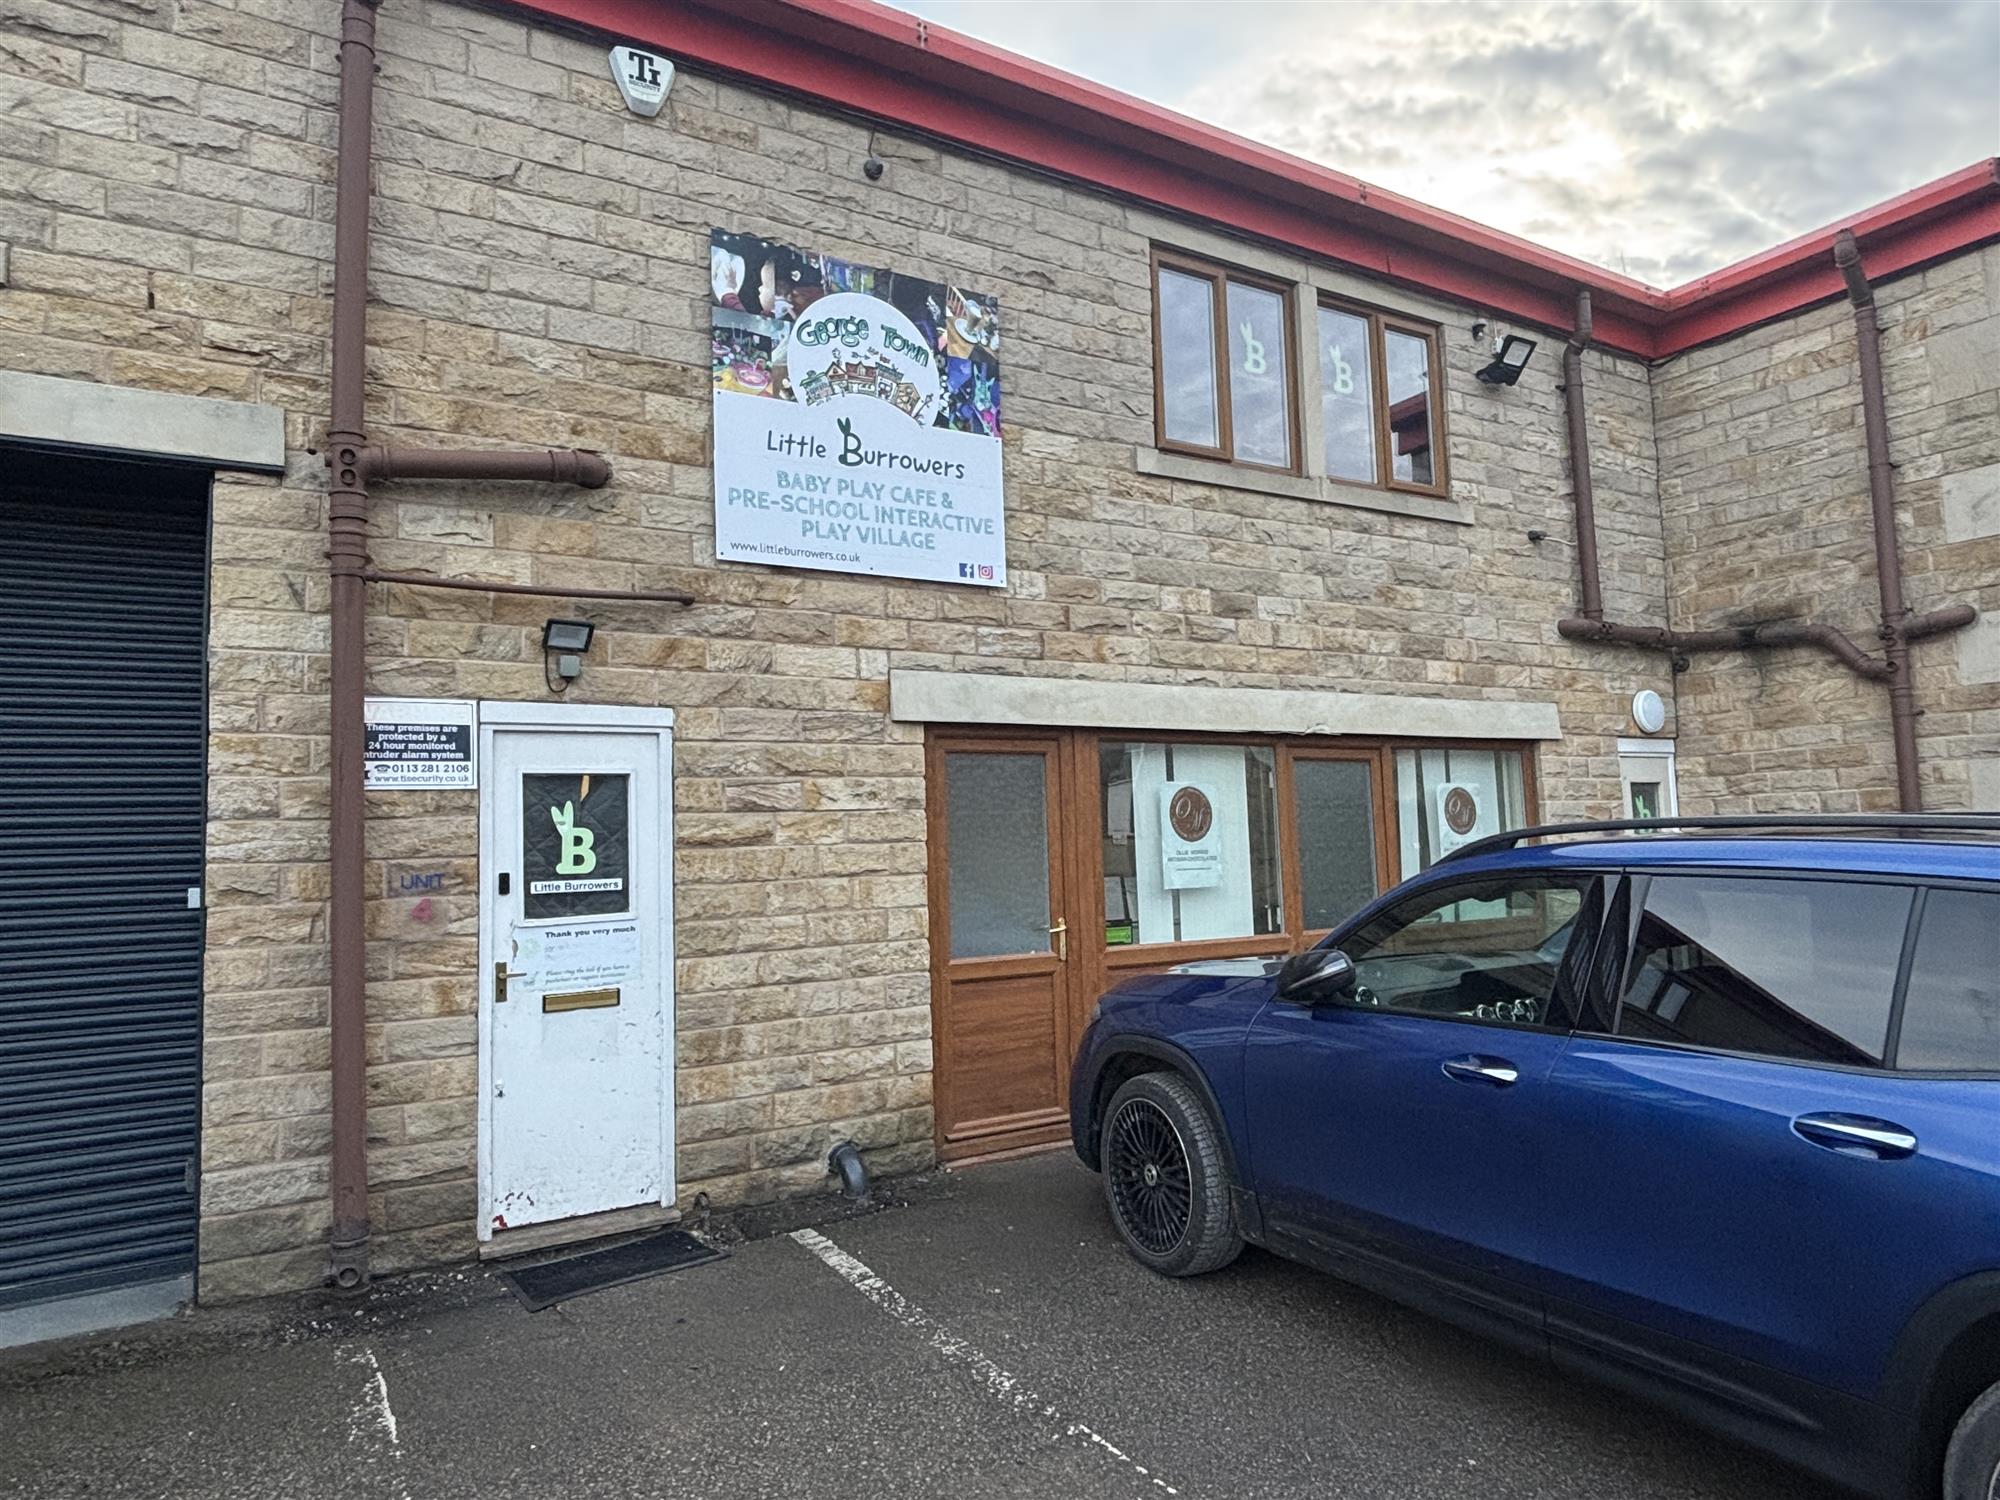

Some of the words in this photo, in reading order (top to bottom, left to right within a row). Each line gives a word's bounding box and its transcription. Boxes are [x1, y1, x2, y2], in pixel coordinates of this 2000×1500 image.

[797, 316, 869, 347] George
[767, 430, 827, 458] Little
[838, 418, 965, 479] Burrowers
[777, 470, 831, 494] BABY
[837, 478, 885, 501] PLAY
[890, 485, 937, 508] CAFE
[941, 491, 954, 509] &
[728, 487, 869, 522] PRE-SCHOOL
[874, 505, 995, 536] INTERACTIVE
[801, 520, 851, 543] PLAY
[856, 526, 936, 551] VILLAGE
[730, 541, 861, 563] www.littleburrowers.co.uk
[366, 723, 396, 732] These
[397, 724, 441, 733] premises
[368, 741, 381, 750] 24
[383, 742, 406, 750] hour
[408, 742, 457, 750] monitored
[378, 733, 424, 742] protected
[426, 733, 439, 743] by
[364, 750, 400, 759] ntruder
[401, 750, 430, 759] alarm
[431, 751, 464, 760] system
[392, 764, 419, 773] 0113
[421, 764, 441, 773] 281
[443, 764, 470, 773] 2106
[401, 873, 446, 890] UNIT
[534, 883, 561, 892] Little
[564, 881, 619, 891] Burrowers
[545, 930, 573, 939] Thank
[575, 930, 591, 938] you
[592, 928, 611, 936] very
[612, 925, 636, 933] much
